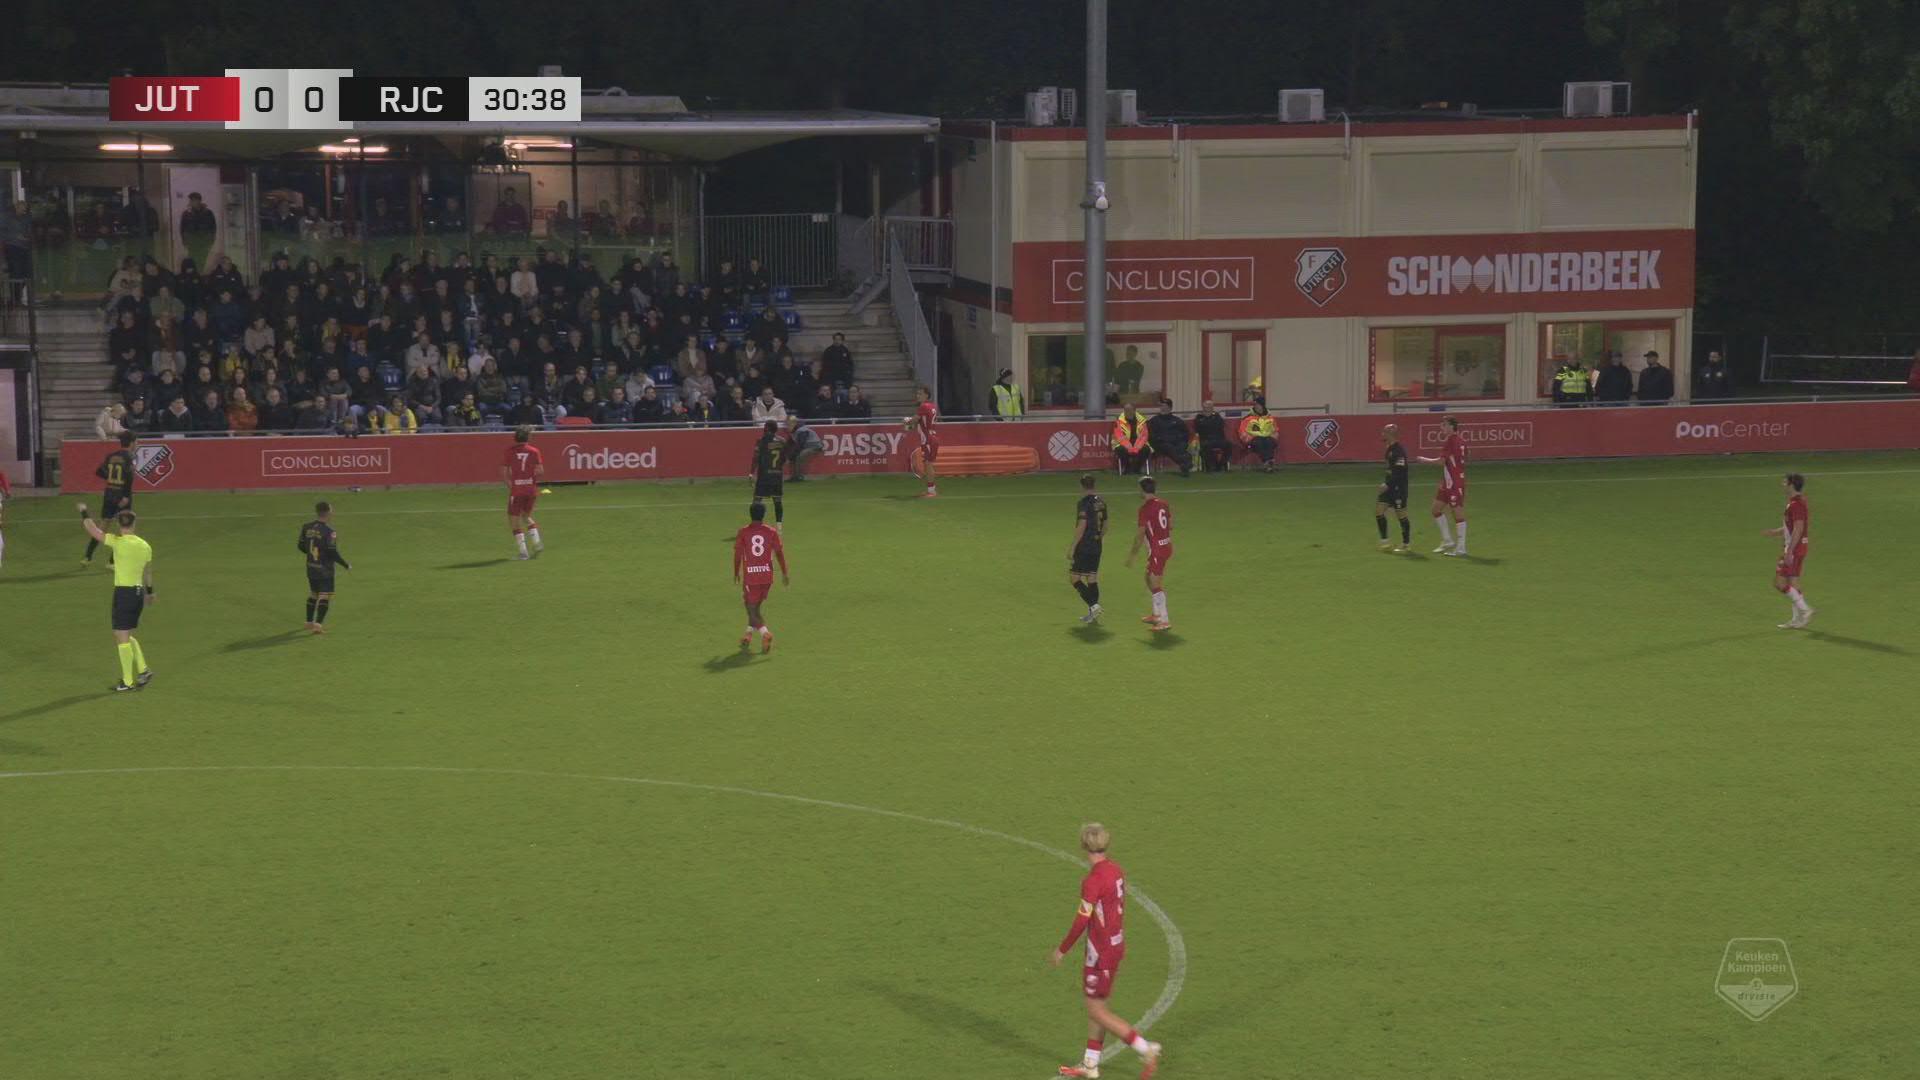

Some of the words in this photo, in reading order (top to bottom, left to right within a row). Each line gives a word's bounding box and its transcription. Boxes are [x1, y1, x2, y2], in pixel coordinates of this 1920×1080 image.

[1066, 269, 1240, 291] CNCLUSION
[1302, 253, 1342, 293] UTRECHT
[1388, 250, 1662, 296] SCHOONDERBEEK
[1082, 433, 1110, 447] LIN
[1427, 429, 1525, 442] COCLUSION
[1675, 420, 1791, 439] PonCenter
[822, 432, 903, 456] DASSY
[271, 454, 383, 470] CONCLUSION
[516, 452, 529, 471] 7
[568, 446, 657, 470] indeed
[1158, 508, 1168, 529] 6
[751, 534, 765, 557] 8
